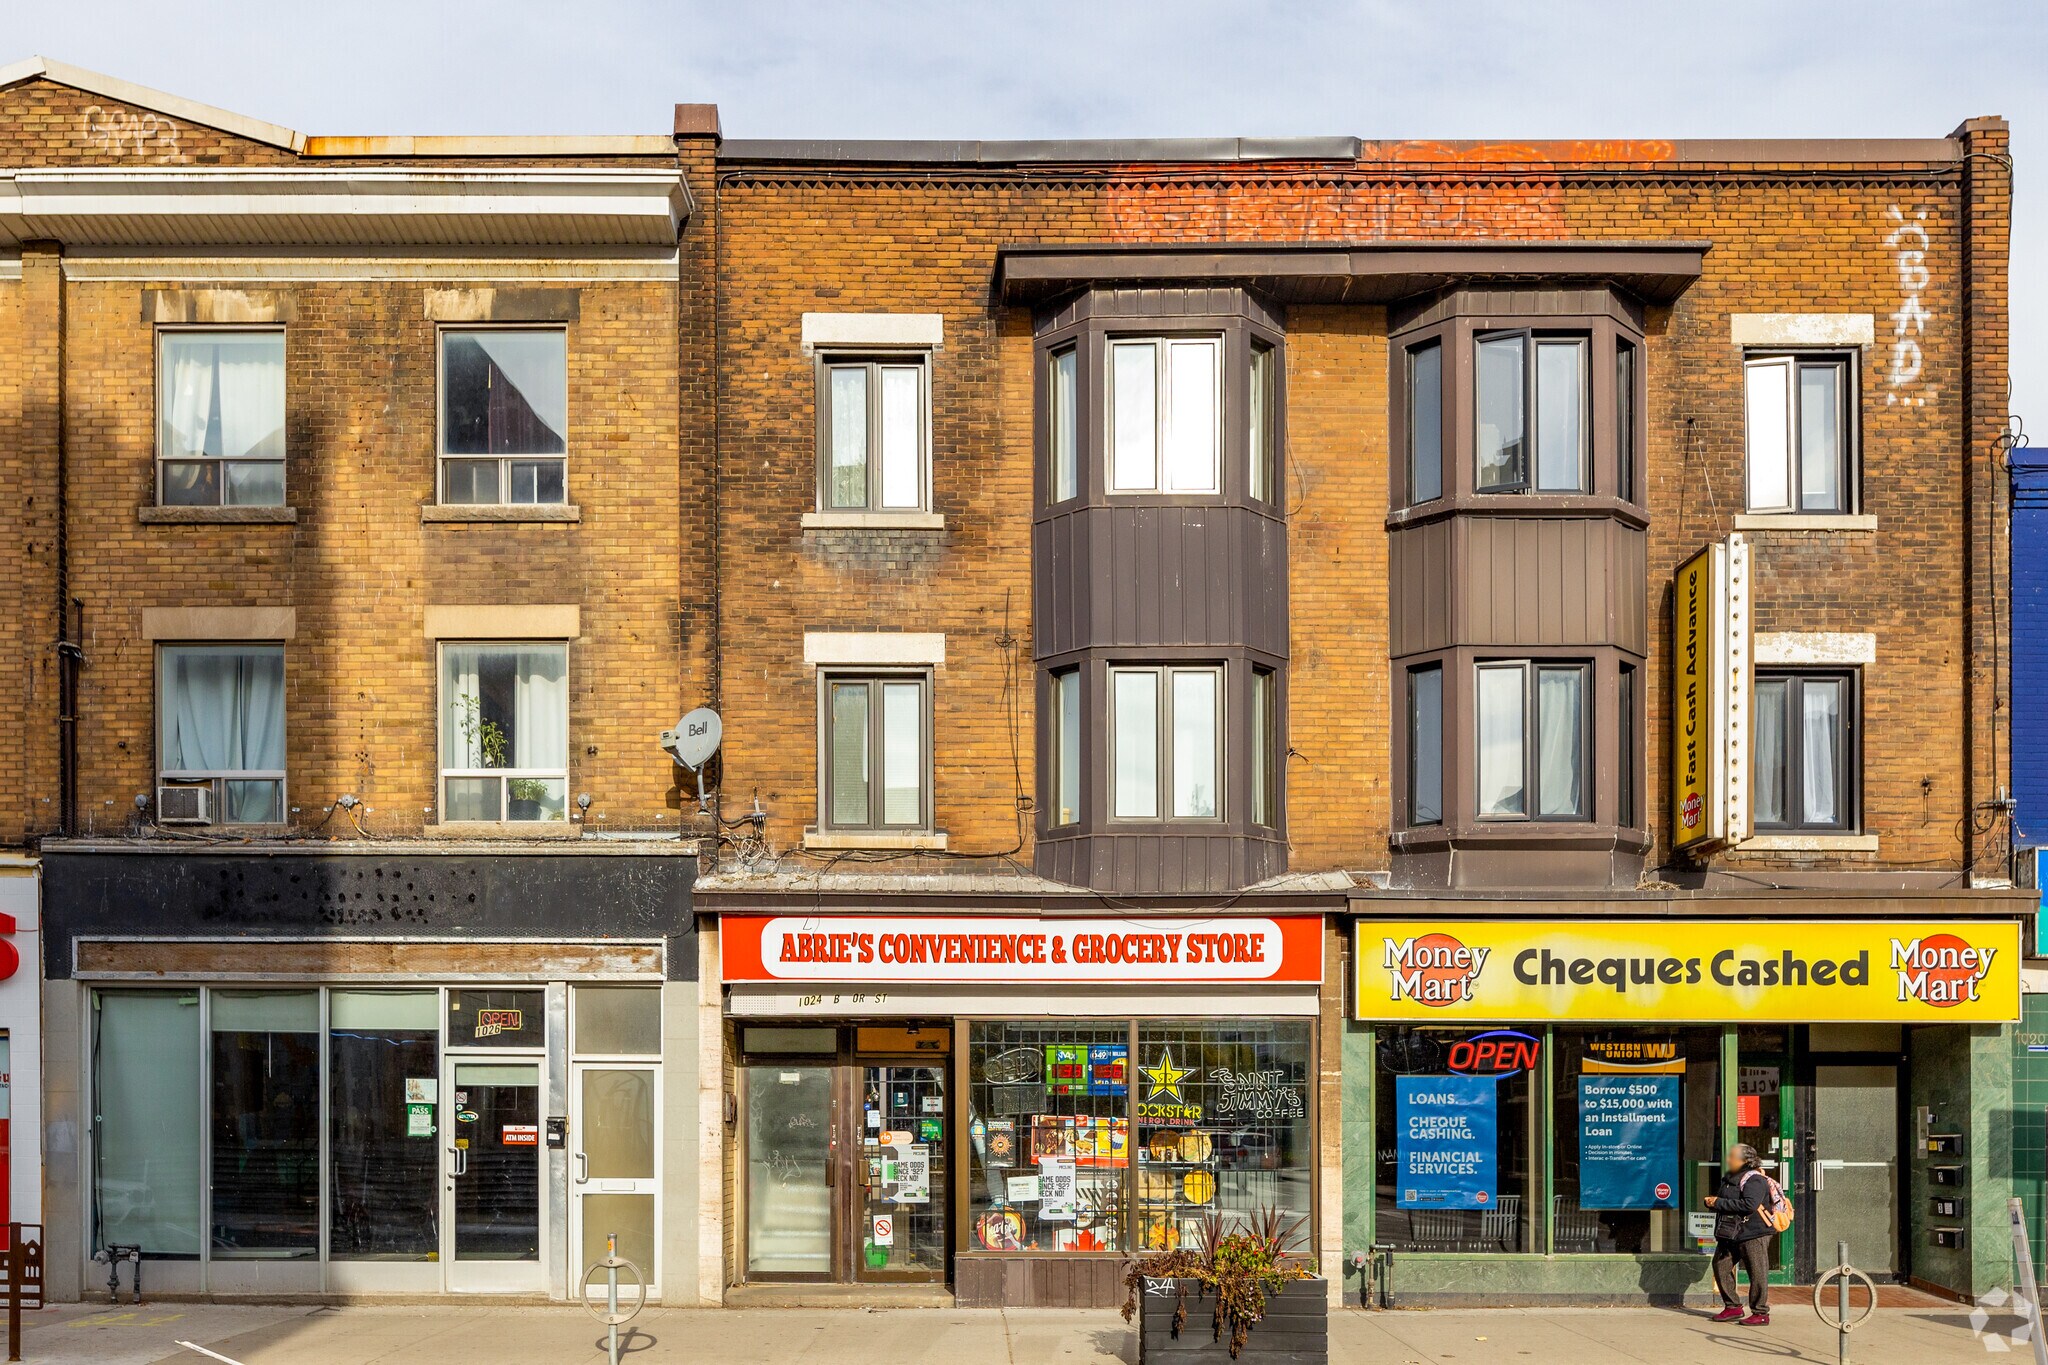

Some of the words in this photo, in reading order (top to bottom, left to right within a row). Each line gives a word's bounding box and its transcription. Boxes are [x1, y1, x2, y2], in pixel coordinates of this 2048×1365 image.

[1685, 569, 1698, 675] Advance
[1685, 681, 1697, 734] Cash
[688, 721, 708, 737] Bell
[1685, 742, 1697, 787] Fast
[1679, 793, 1705, 817] Money
[1681, 811, 1701, 830] Mart
[780, 931, 874, 964] ABRIE'S
[879, 933, 1046, 964] CONVENIENCE
[1051, 934, 1067, 963] &
[1072, 934, 1182, 964] GROCERY
[1186, 932, 1265, 964] STORE
[1383, 938, 1490, 978] Money
[1889, 938, 1997, 979] Money
[1513, 948, 1702, 993] Cheques
[1711, 949, 1869, 986] Cashed
[1390, 970, 1474, 1002] Mart
[1897, 971, 1981, 1002] Mart
[799, 994, 822, 1007] 1024
[852, 993, 865, 1003] OR
[874, 993, 888, 1003] ST
[481, 1011, 519, 1027] OPEN
[476, 1023, 500, 1037] 1026
[1590, 1043, 1641, 1051] WESTERN
[1447, 1041, 1541, 1070] OPEN
[1209, 1068, 1284, 1093] SAINT
[1584, 1085, 1626, 1095] Borrow
[1628, 1084, 1657, 1095] $500
[1409, 1093, 1459, 1105] LOANS.
[1584, 1099, 1597, 1108] to
[1600, 1098, 1645, 1109] $15,000
[1647, 1099, 1673, 1108] with
[411, 1107, 429, 1115] PASS
[1256, 1108, 1304, 1119] COFFEE
[1584, 1114, 1599, 1122] an
[1601, 1113, 1666, 1122] Installment
[1170, 1117, 1195, 1126] DRINK
[1409, 1116, 1467, 1129] CHEQUE
[505, 1134, 517, 1142] ATM
[518, 1134, 535, 1142] INSIDE
[1409, 1129, 1476, 1139] CASHING.
[1585, 1126, 1613, 1136] Loan
[1410, 1151, 1483, 1163] FINANCIAL
[1409, 1163, 1478, 1175] SERVICES.
